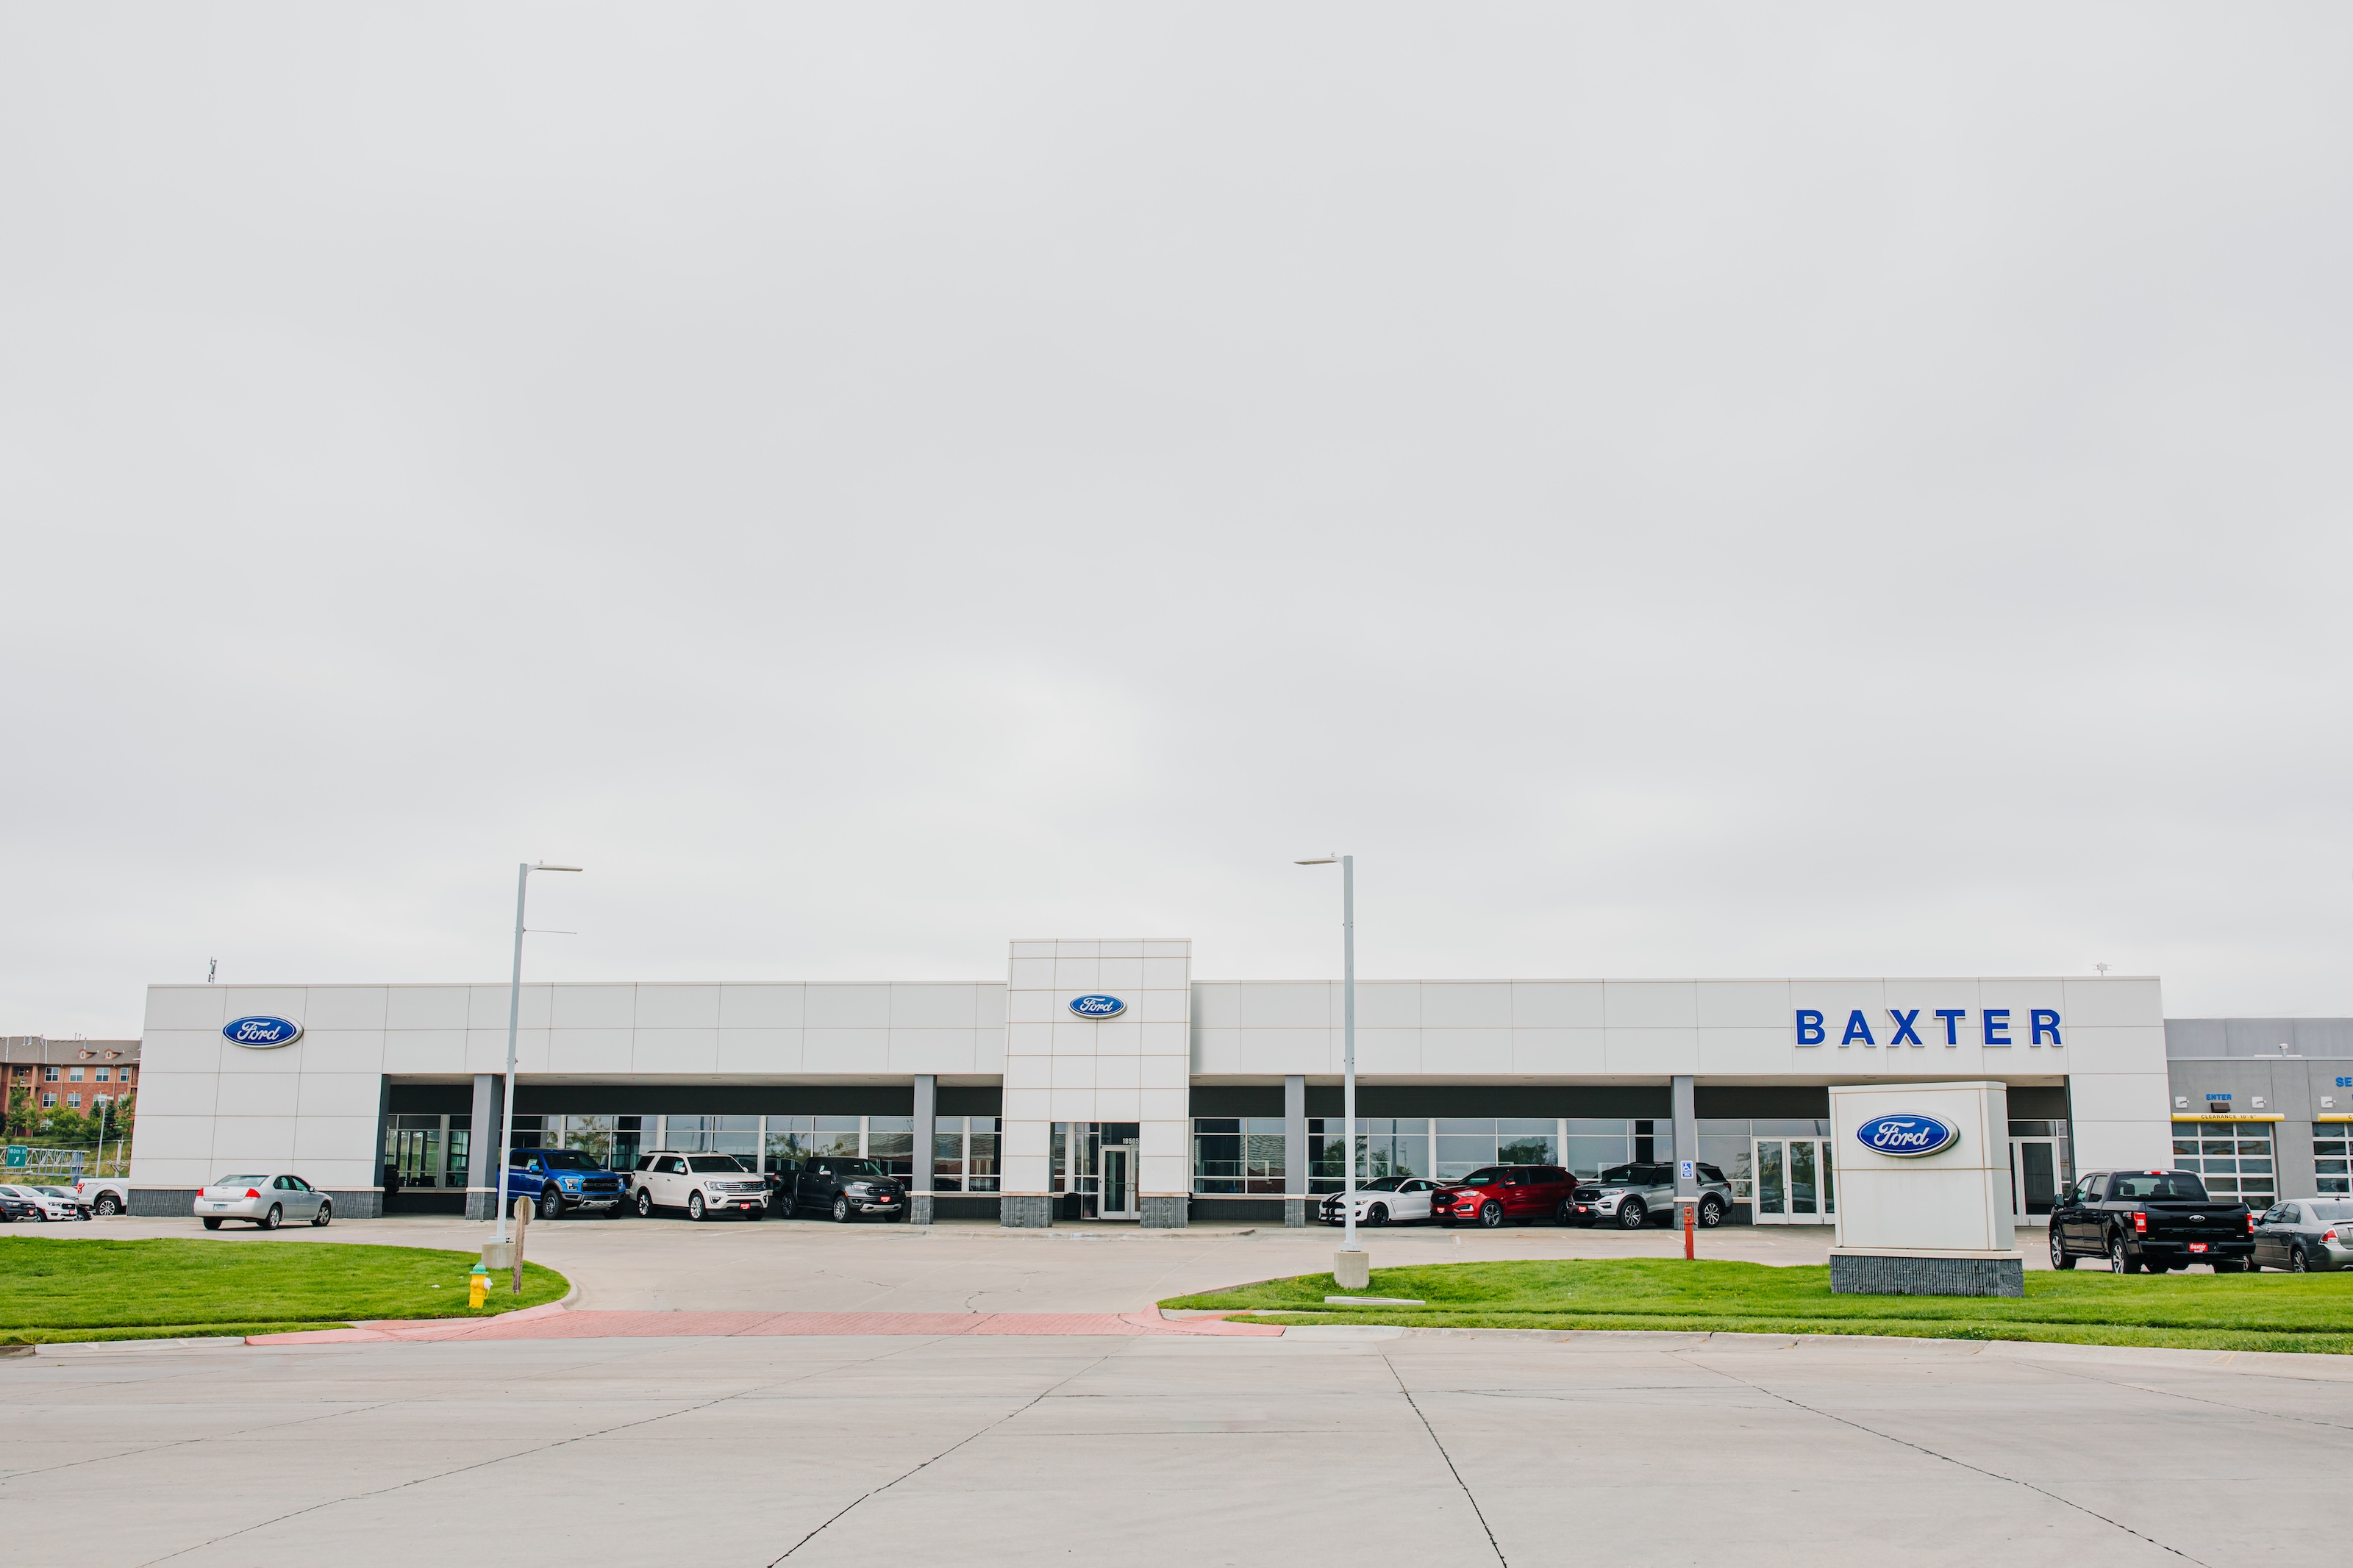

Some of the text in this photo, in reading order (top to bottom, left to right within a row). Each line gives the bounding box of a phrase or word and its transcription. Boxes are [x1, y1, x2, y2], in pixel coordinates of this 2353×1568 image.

[1079, 998, 1114, 1012] Ford
[237, 1021, 281, 1040] Ford
[1795, 1008, 2063, 1047] BAXTER
[1874, 1121, 1930, 1146] Ford
